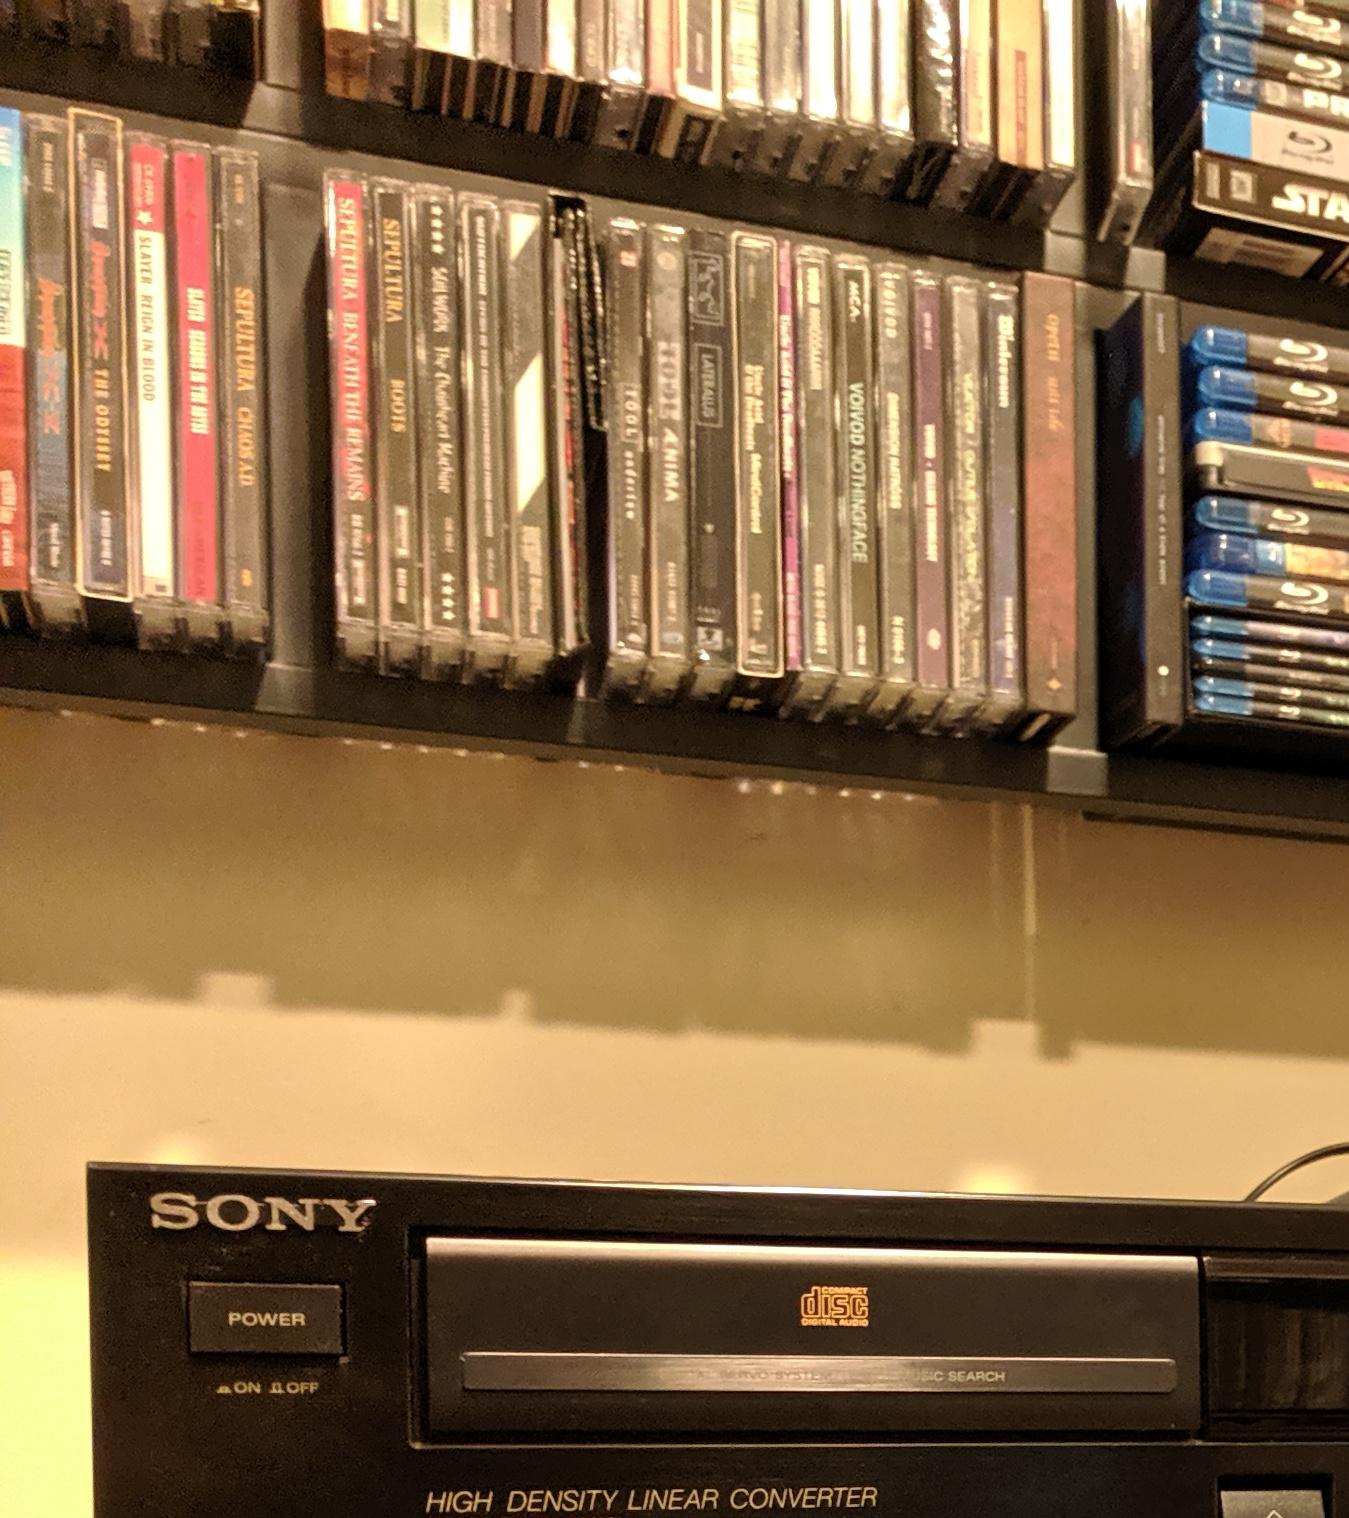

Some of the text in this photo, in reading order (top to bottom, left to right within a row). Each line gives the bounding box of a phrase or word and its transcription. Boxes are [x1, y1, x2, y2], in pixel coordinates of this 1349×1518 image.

[383, 219, 403, 323] SEPULTURA
[139, 237, 156, 401] SLAYER REIGN BLOOD
[339, 198, 364, 500] SEPULTURA BENEATH THE REMAINS
[236, 286, 254, 459] SEPULTURA CHAOS
[624, 388, 637, 438] TOOL
[849, 383, 867, 562] VOIVOD NOTHINGFACE
[149, 1192, 376, 1233] SONY
[228, 1312, 306, 1328] POWER
[800, 1287, 869, 1318] disc
[234, 1381, 261, 1395] ON
[286, 1381, 320, 1394] OFF
[950, 1371, 1005, 1382] SEARCH
[425, 1486, 878, 1514] HIGH DENSITY LINEAR CONVERTER
